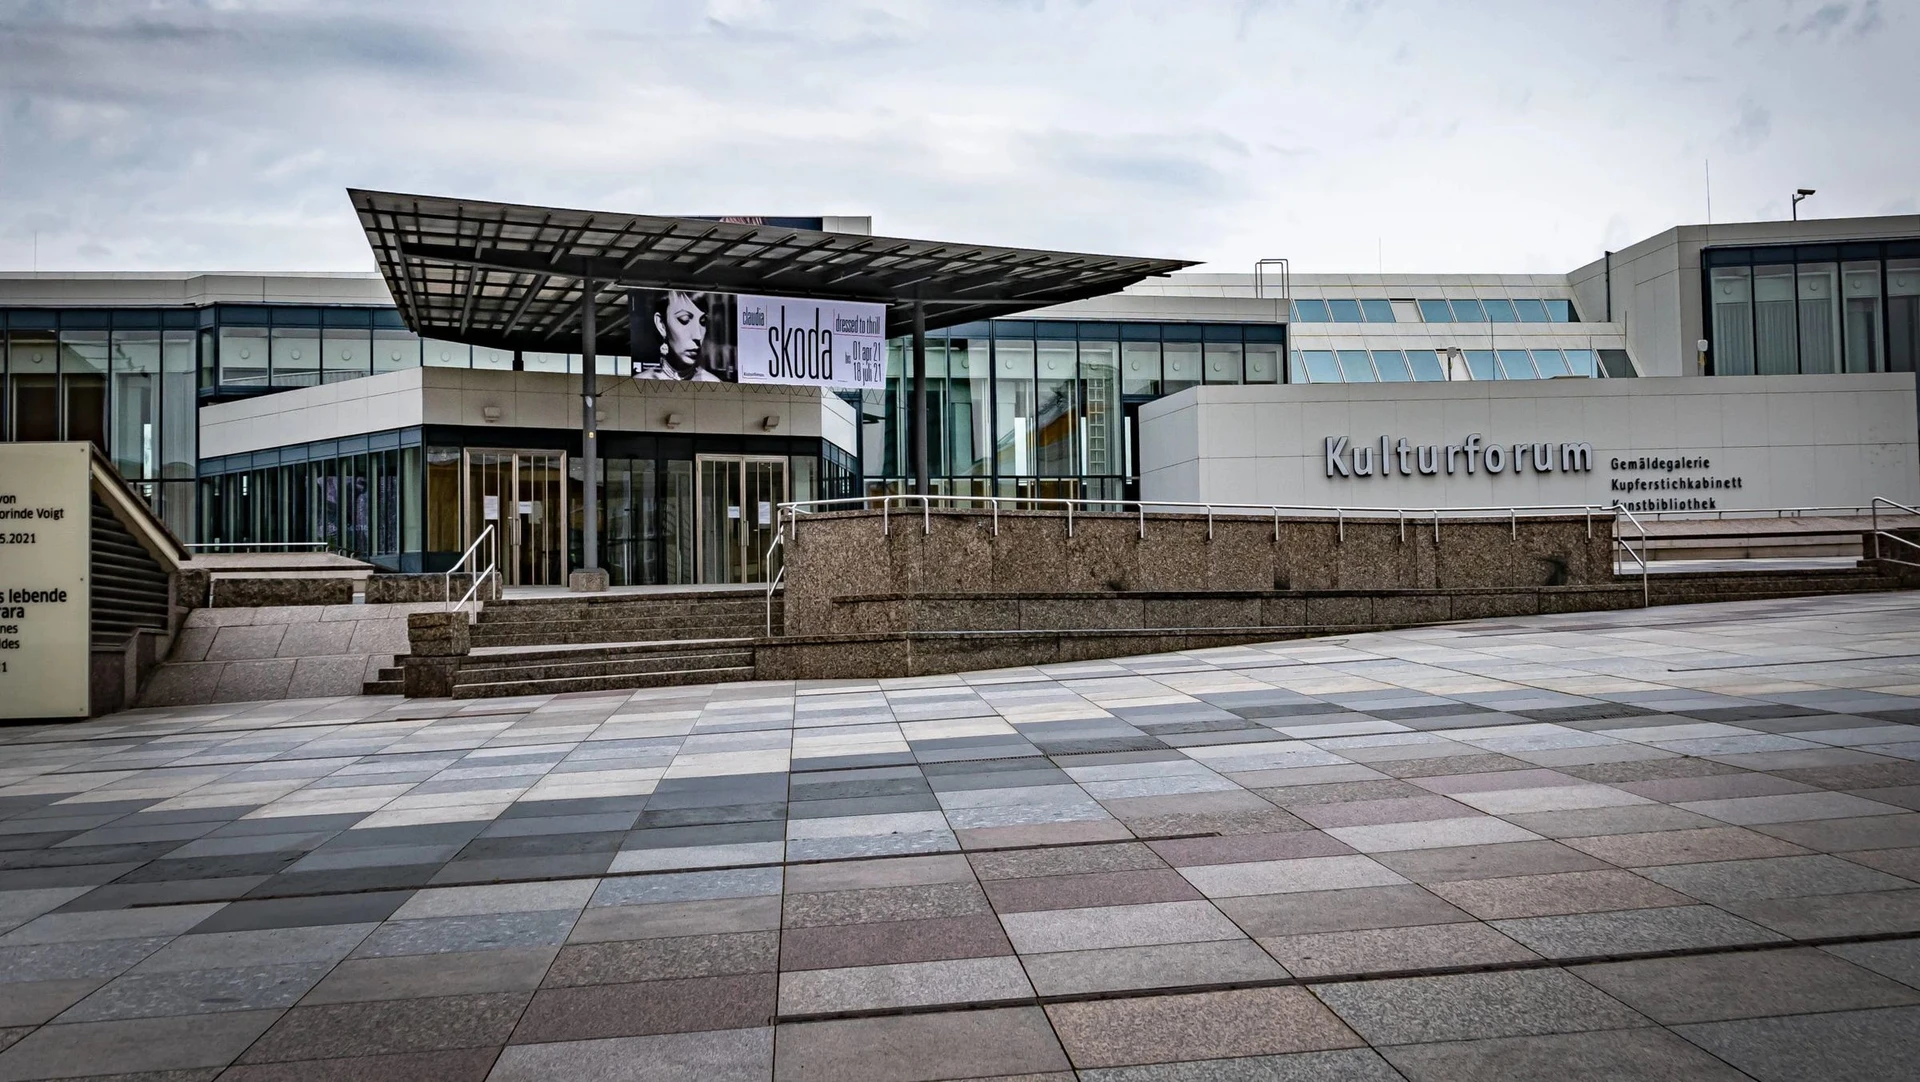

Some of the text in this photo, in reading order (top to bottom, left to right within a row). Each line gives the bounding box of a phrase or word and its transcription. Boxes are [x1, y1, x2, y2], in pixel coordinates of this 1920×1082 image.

[742, 306, 765, 327] claudia
[836, 313, 881, 335] dressed to thrill
[768, 305, 833, 380] skoda
[853, 341, 881, 365] 01 apr 21
[853, 362, 881, 386] 18 juli 21
[1325, 433, 1593, 477] Kulturforum
[1611, 456, 1710, 472] Gemäldegalerie
[1611, 476, 1743, 493] Kupferstichkabinett
[36, 508, 64, 520] Voigt
[9, 588, 67, 603] lebende
[0, 606, 25, 618] ara
